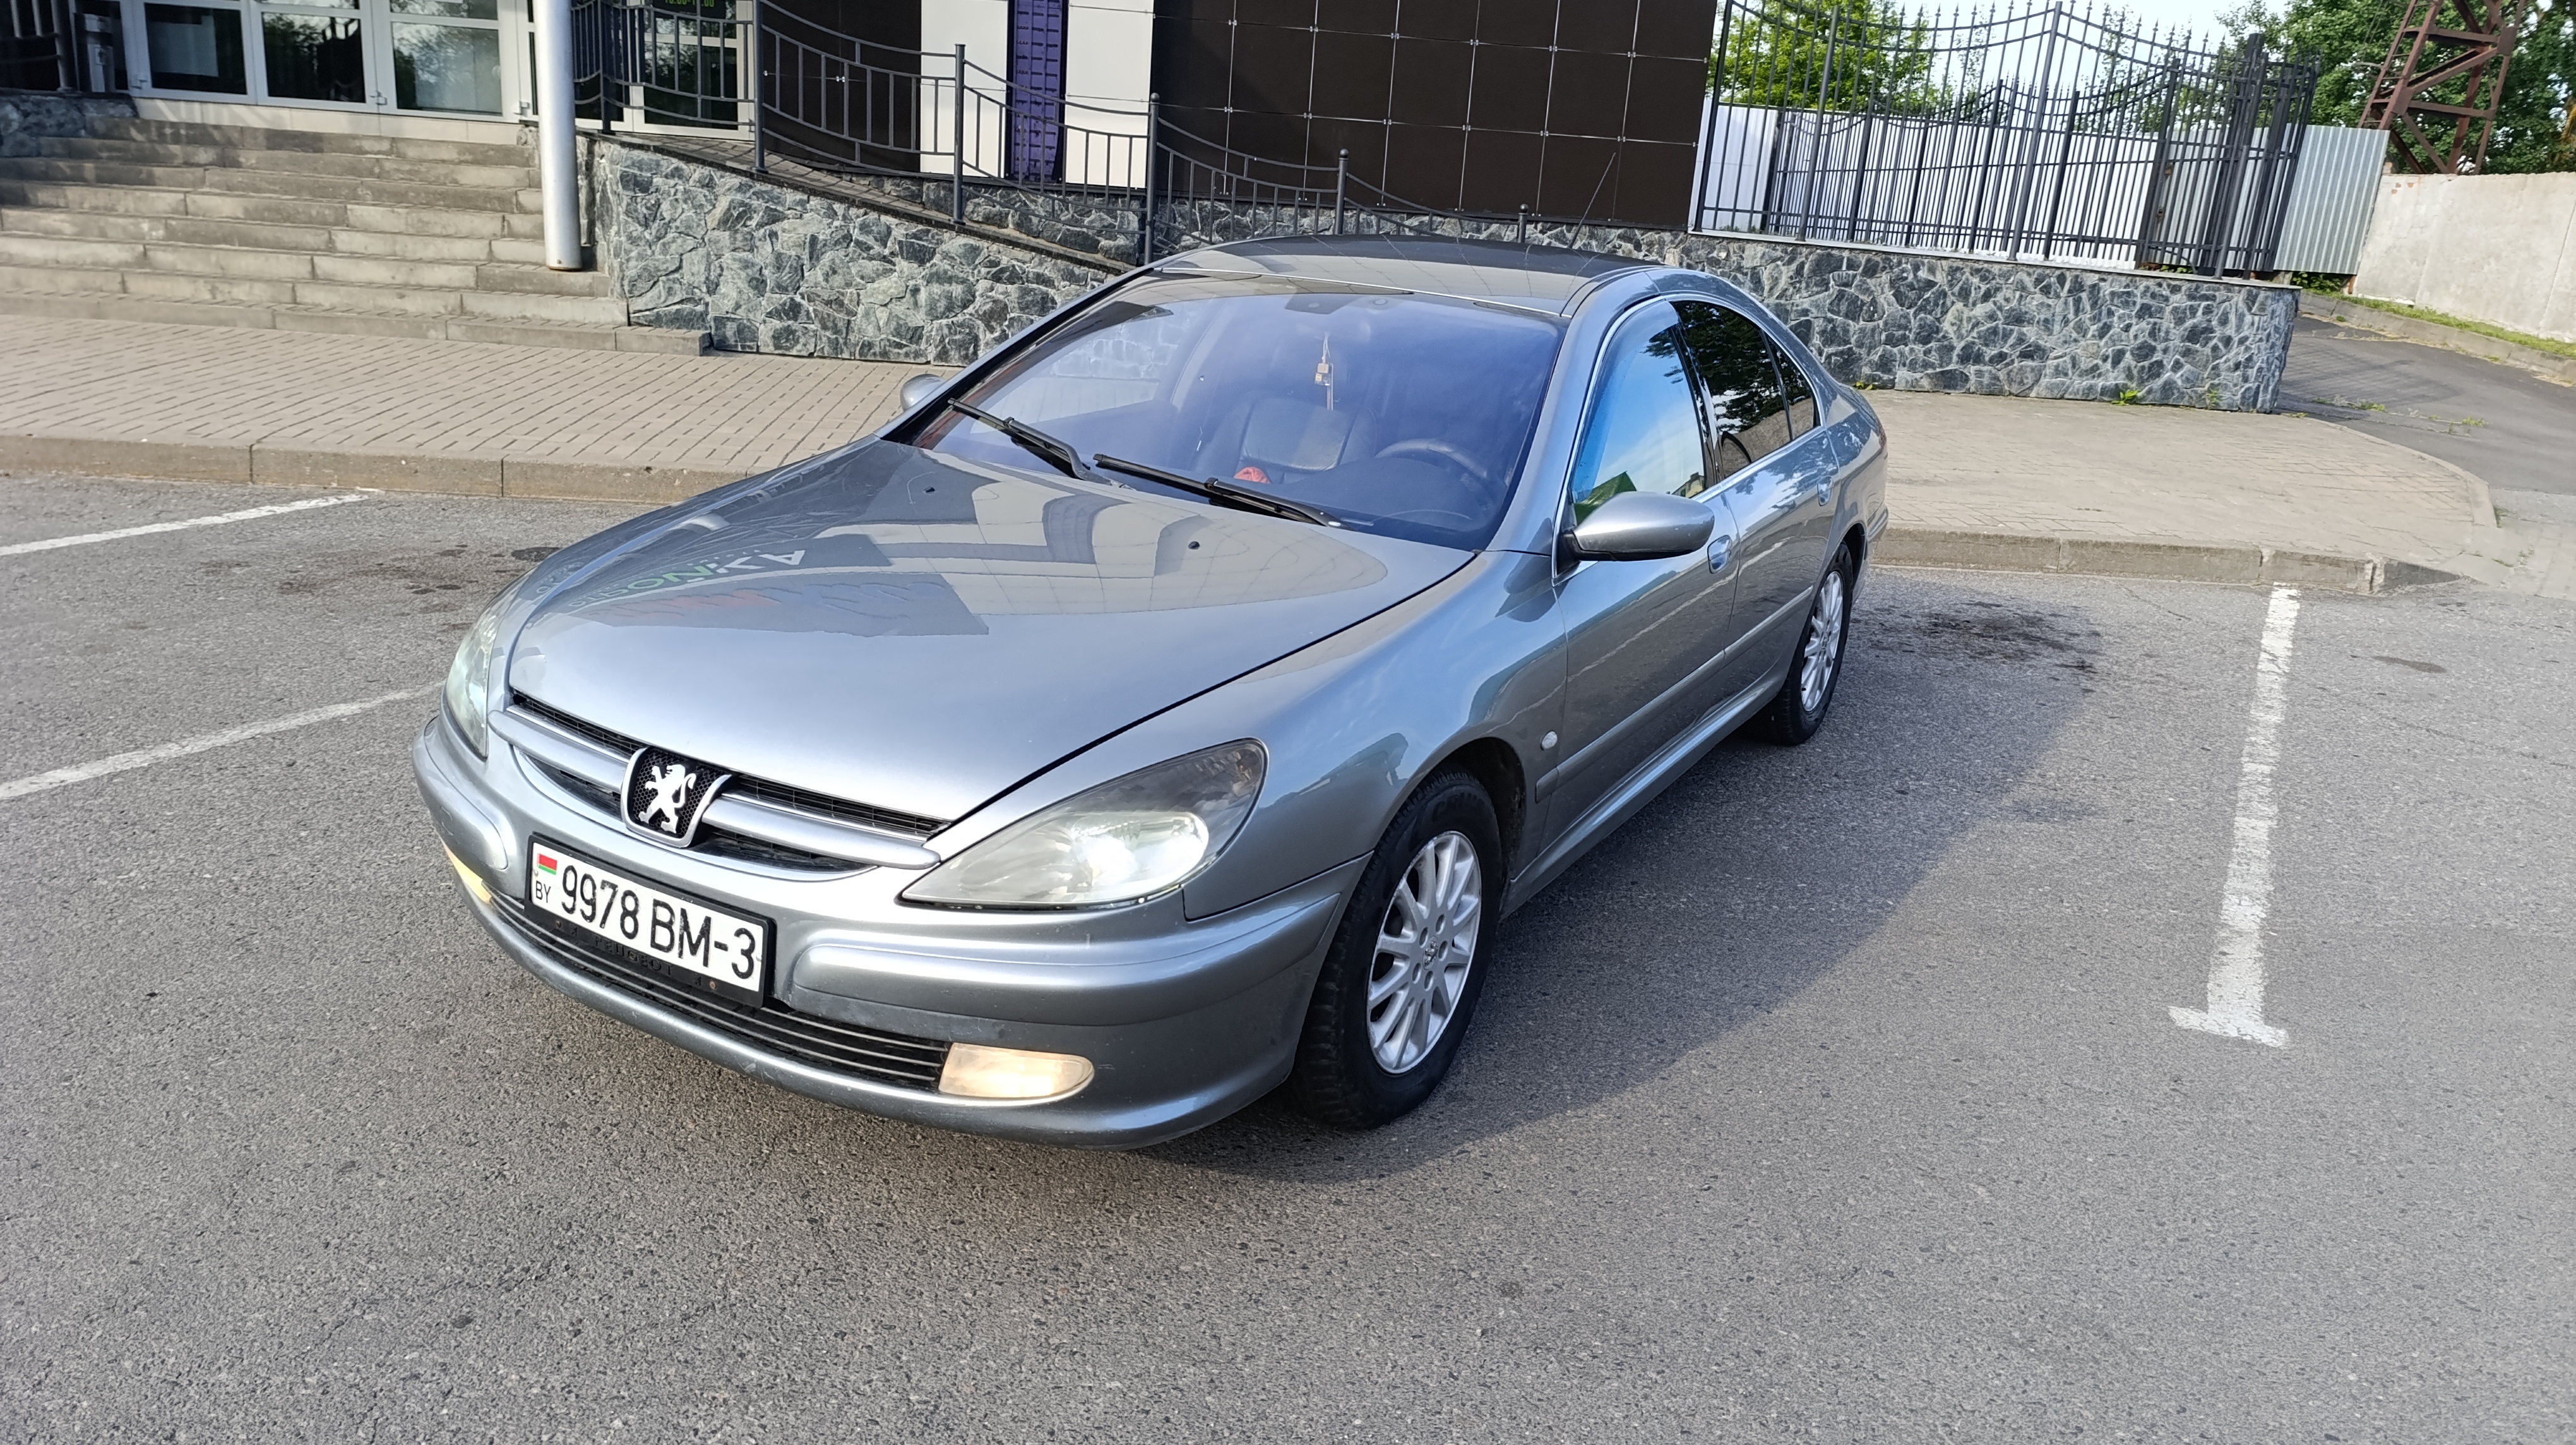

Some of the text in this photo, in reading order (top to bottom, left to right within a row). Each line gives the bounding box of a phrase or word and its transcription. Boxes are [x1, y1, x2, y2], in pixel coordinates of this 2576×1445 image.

[535, 880, 551, 903] BY
[561, 865, 756, 979] 9978 BM-3
[595, 936, 674, 976] PEUGEOT
